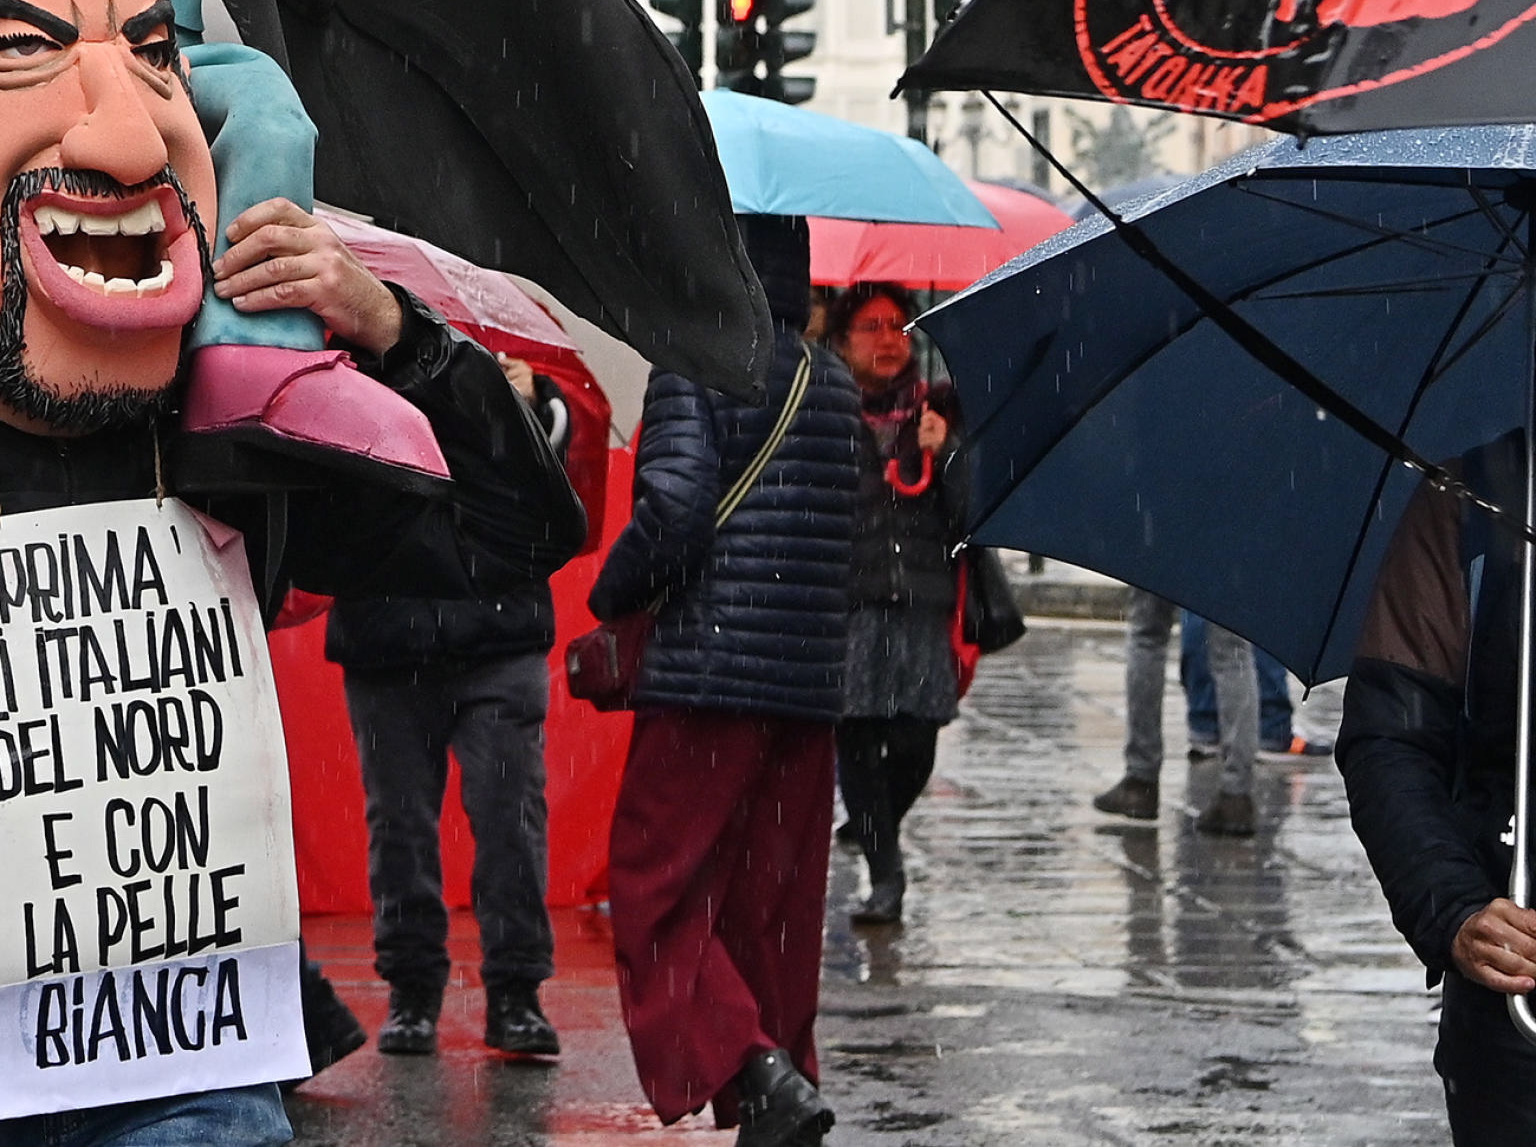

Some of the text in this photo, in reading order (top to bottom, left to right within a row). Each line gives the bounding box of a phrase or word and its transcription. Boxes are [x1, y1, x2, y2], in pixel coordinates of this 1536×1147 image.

[1101, 14, 1268, 112] TATONKA
[35, 597, 243, 708] ITALIANI
[95, 689, 223, 783] NORD
[44, 785, 209, 890] E CON
[24, 864, 245, 979] LA PELLE
